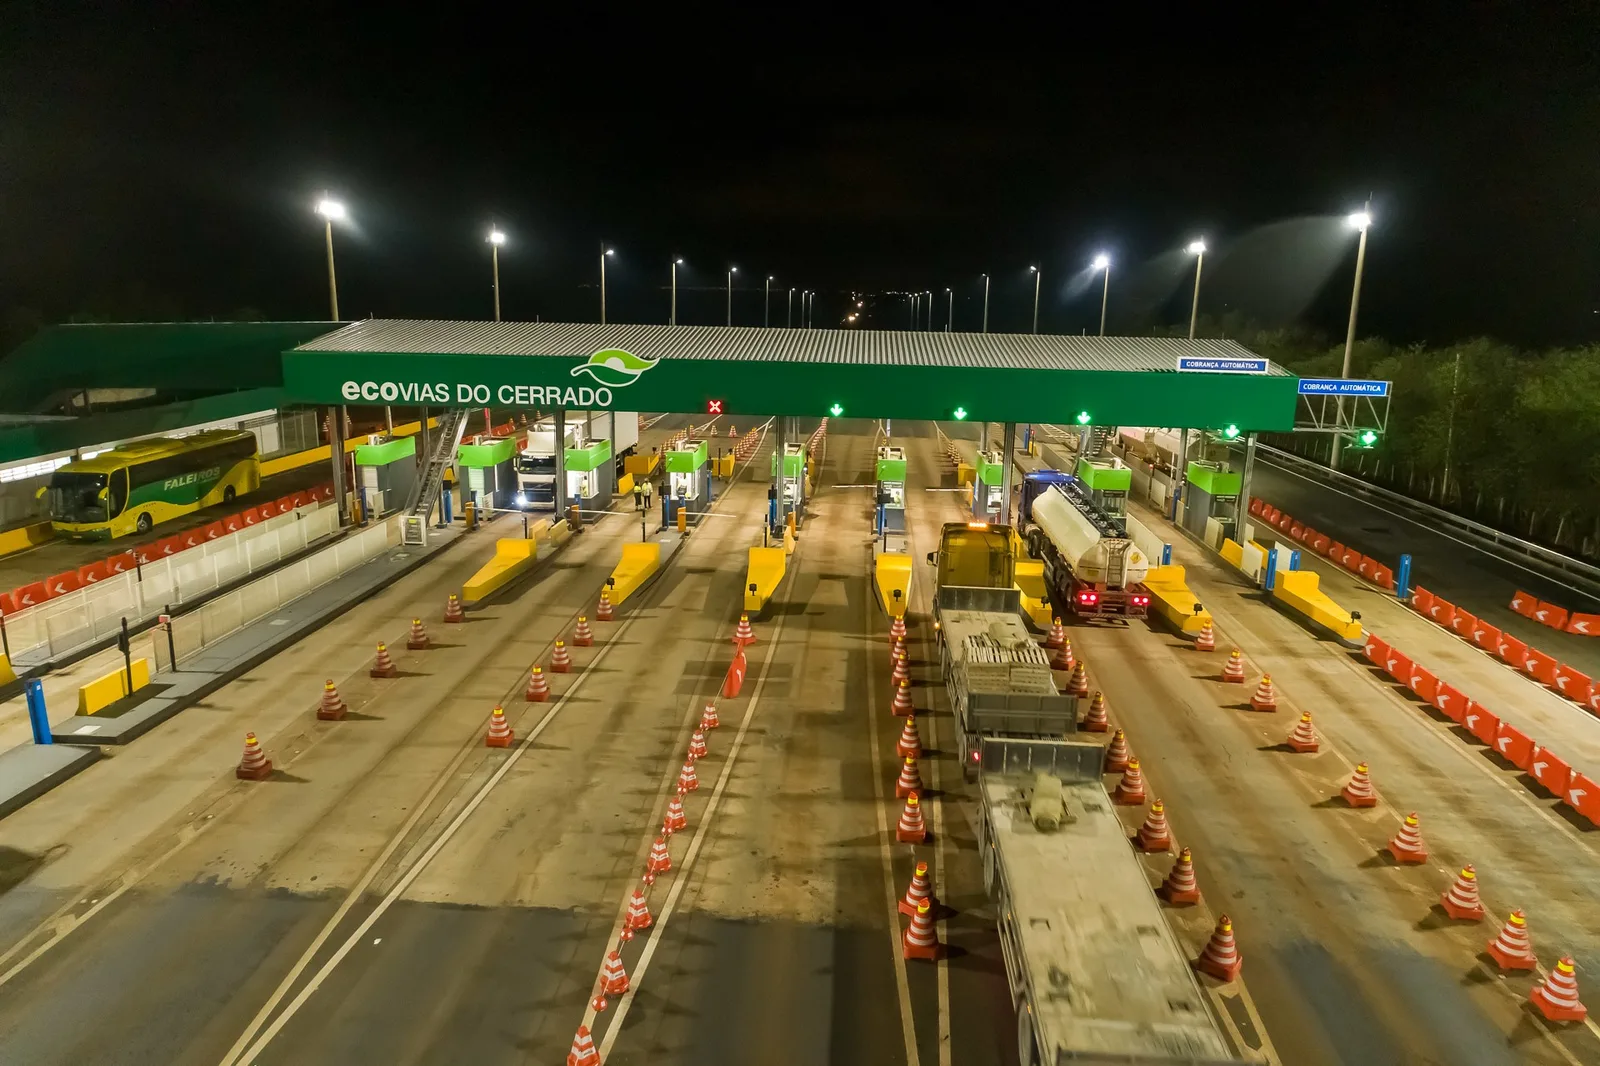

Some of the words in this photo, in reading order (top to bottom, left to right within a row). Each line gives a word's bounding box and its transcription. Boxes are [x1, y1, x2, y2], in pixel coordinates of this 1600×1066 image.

[1220, 361, 1259, 369] AUTOMÁTICA
[341, 381, 450, 403] ecoVIAS
[457, 384, 491, 404] DO
[497, 385, 613, 407] CERRADO
[1303, 383, 1337, 391] COBRANÇA
[1340, 384, 1381, 392] AUTOMÁTICA
[164, 467, 220, 491] FALEIROS
